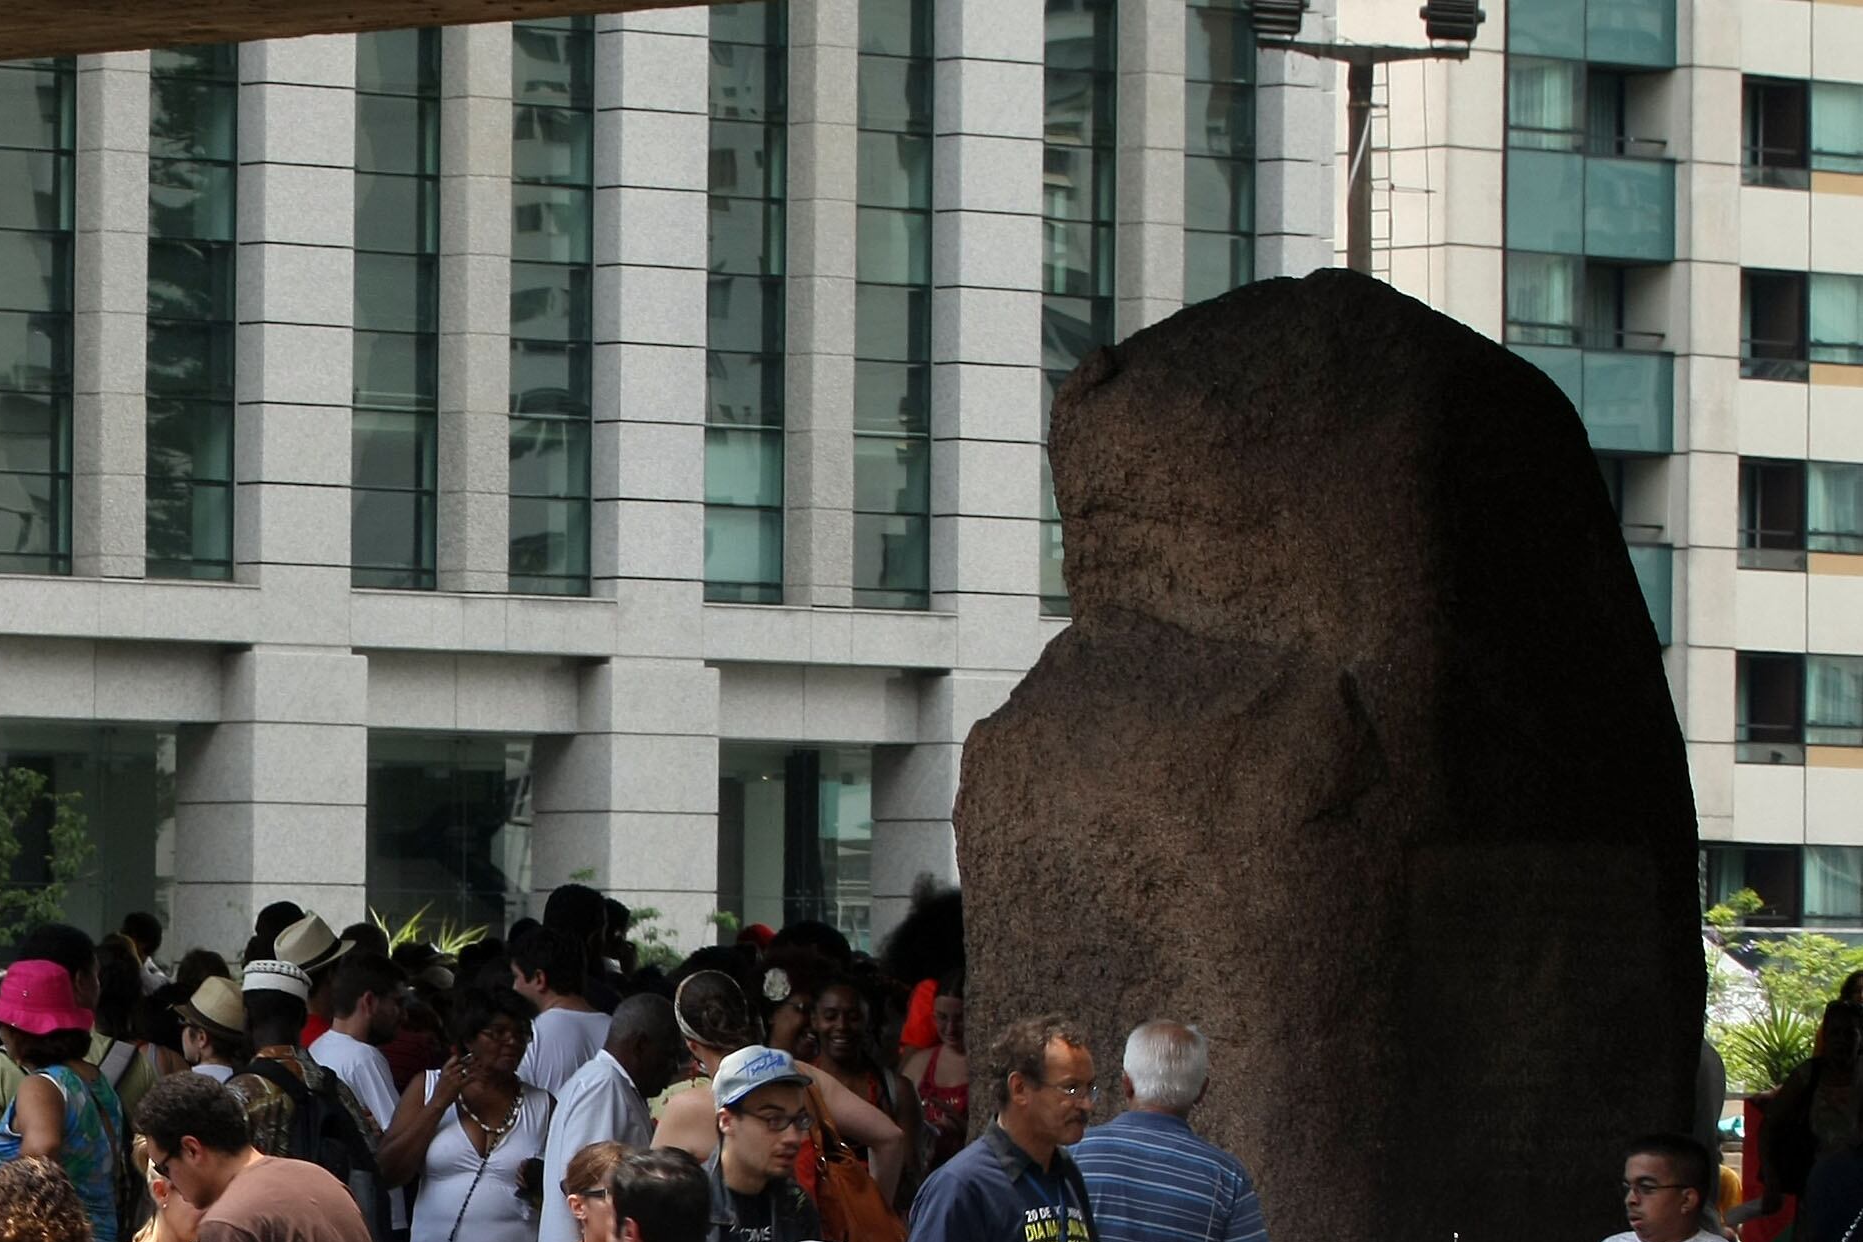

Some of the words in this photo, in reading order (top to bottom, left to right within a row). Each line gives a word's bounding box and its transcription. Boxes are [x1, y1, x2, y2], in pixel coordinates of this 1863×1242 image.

[1025, 1208, 1038, 1222] 20
[1038, 1206, 1051, 1219] DE
[1025, 1221, 1046, 1242] DIA
